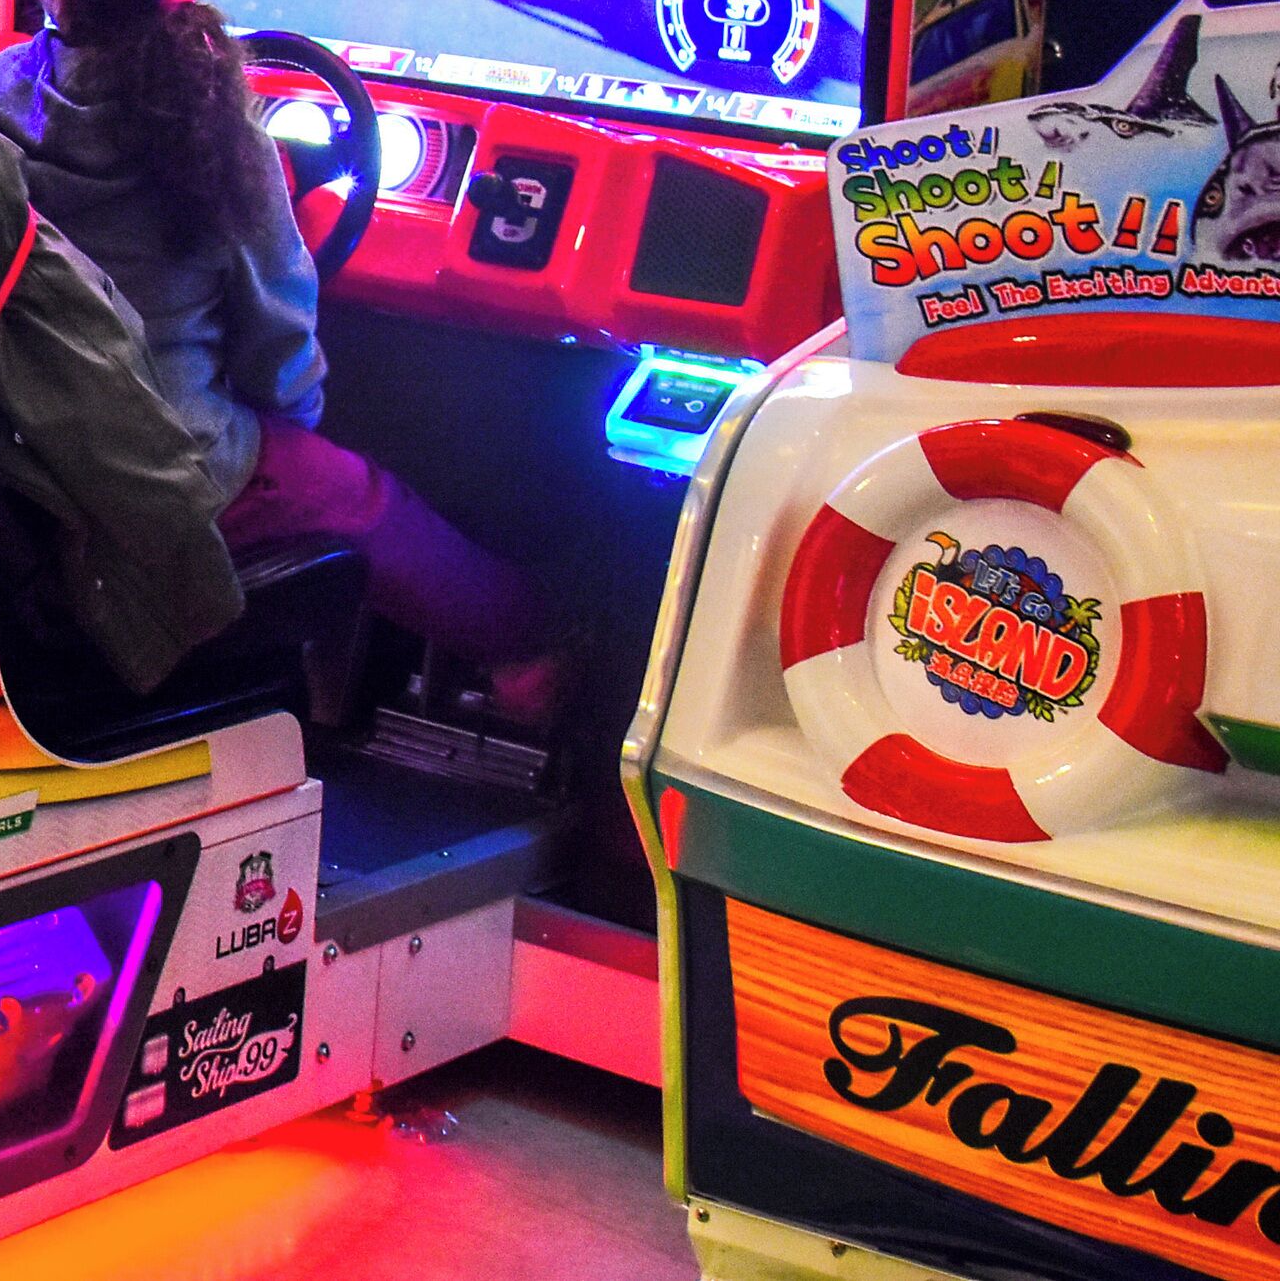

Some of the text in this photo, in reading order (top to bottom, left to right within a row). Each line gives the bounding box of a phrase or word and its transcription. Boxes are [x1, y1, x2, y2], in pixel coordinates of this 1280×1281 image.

[922, 289, 983, 323] Feel
[994, 280, 1043, 309] The
[1046, 270, 1171, 301] Exciting
[215, 917, 277, 960] LUBA
[178, 1006, 253, 1059] Sailing
[191, 1036, 279, 1100] Ship 99
